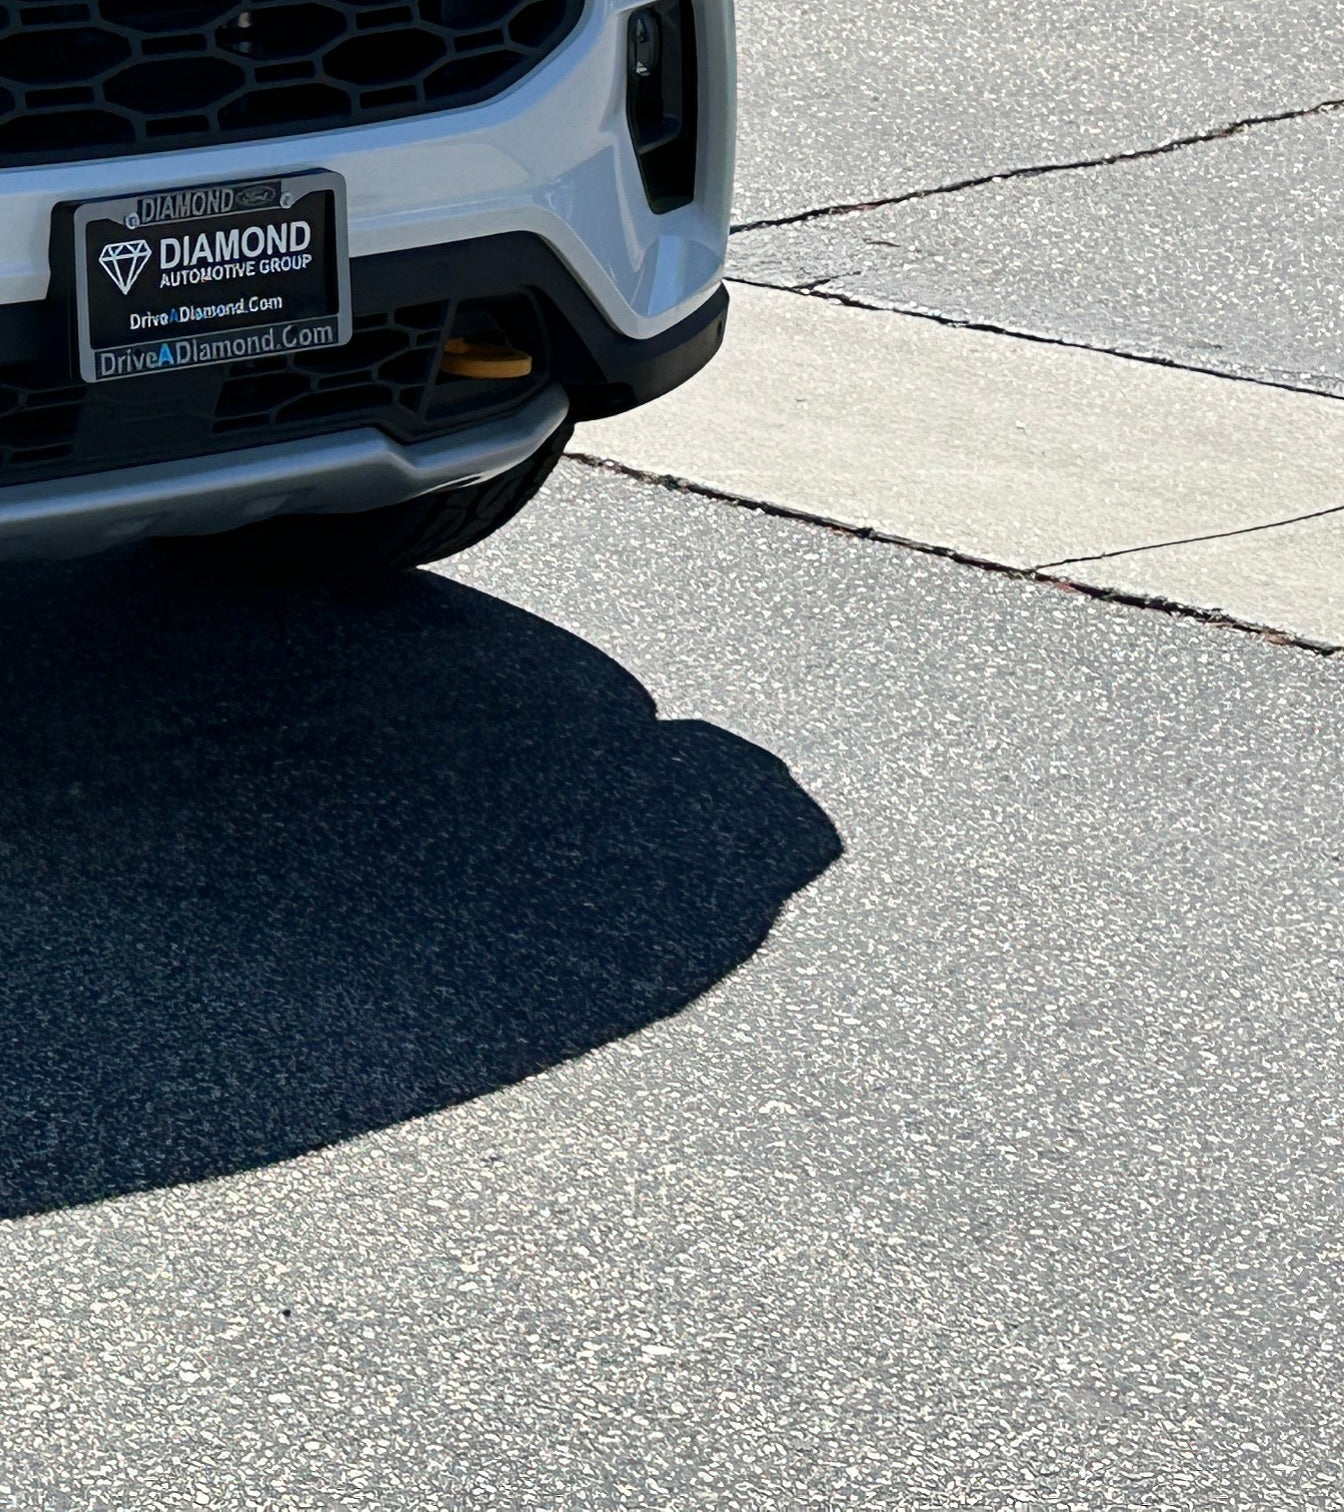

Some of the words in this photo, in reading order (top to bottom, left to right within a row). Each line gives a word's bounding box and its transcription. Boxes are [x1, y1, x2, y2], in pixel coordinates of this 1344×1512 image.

[141, 187, 235, 224] DIAMOND
[158, 219, 313, 271] DIAMOND
[158, 259, 258, 289] AUTOMOTIVE
[258, 253, 313, 274] GROUP
[128, 294, 284, 331] DriveADiamond.Com
[99, 323, 335, 377] DriveADiamond.Com
